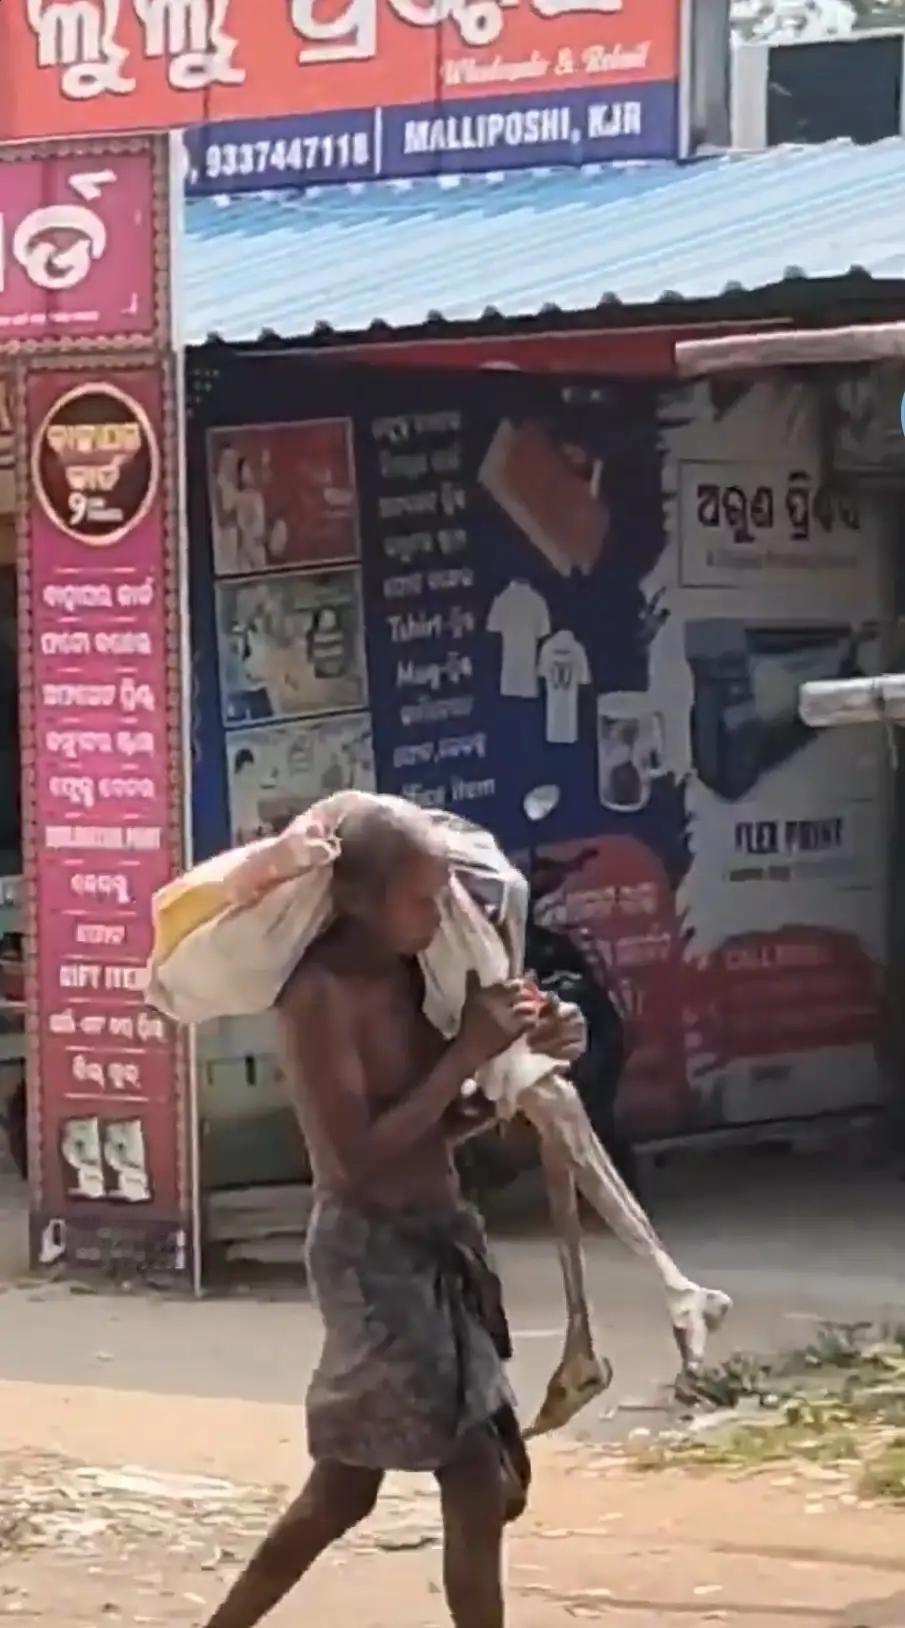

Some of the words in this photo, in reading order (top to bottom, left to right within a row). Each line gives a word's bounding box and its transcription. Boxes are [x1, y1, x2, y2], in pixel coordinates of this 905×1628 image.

[205, 132, 370, 178] 9337447118
[404, 107, 581, 154] MALLIPOSHI,
[588, 102, 643, 138] KJR
[60, 964, 101, 989] GIFT
